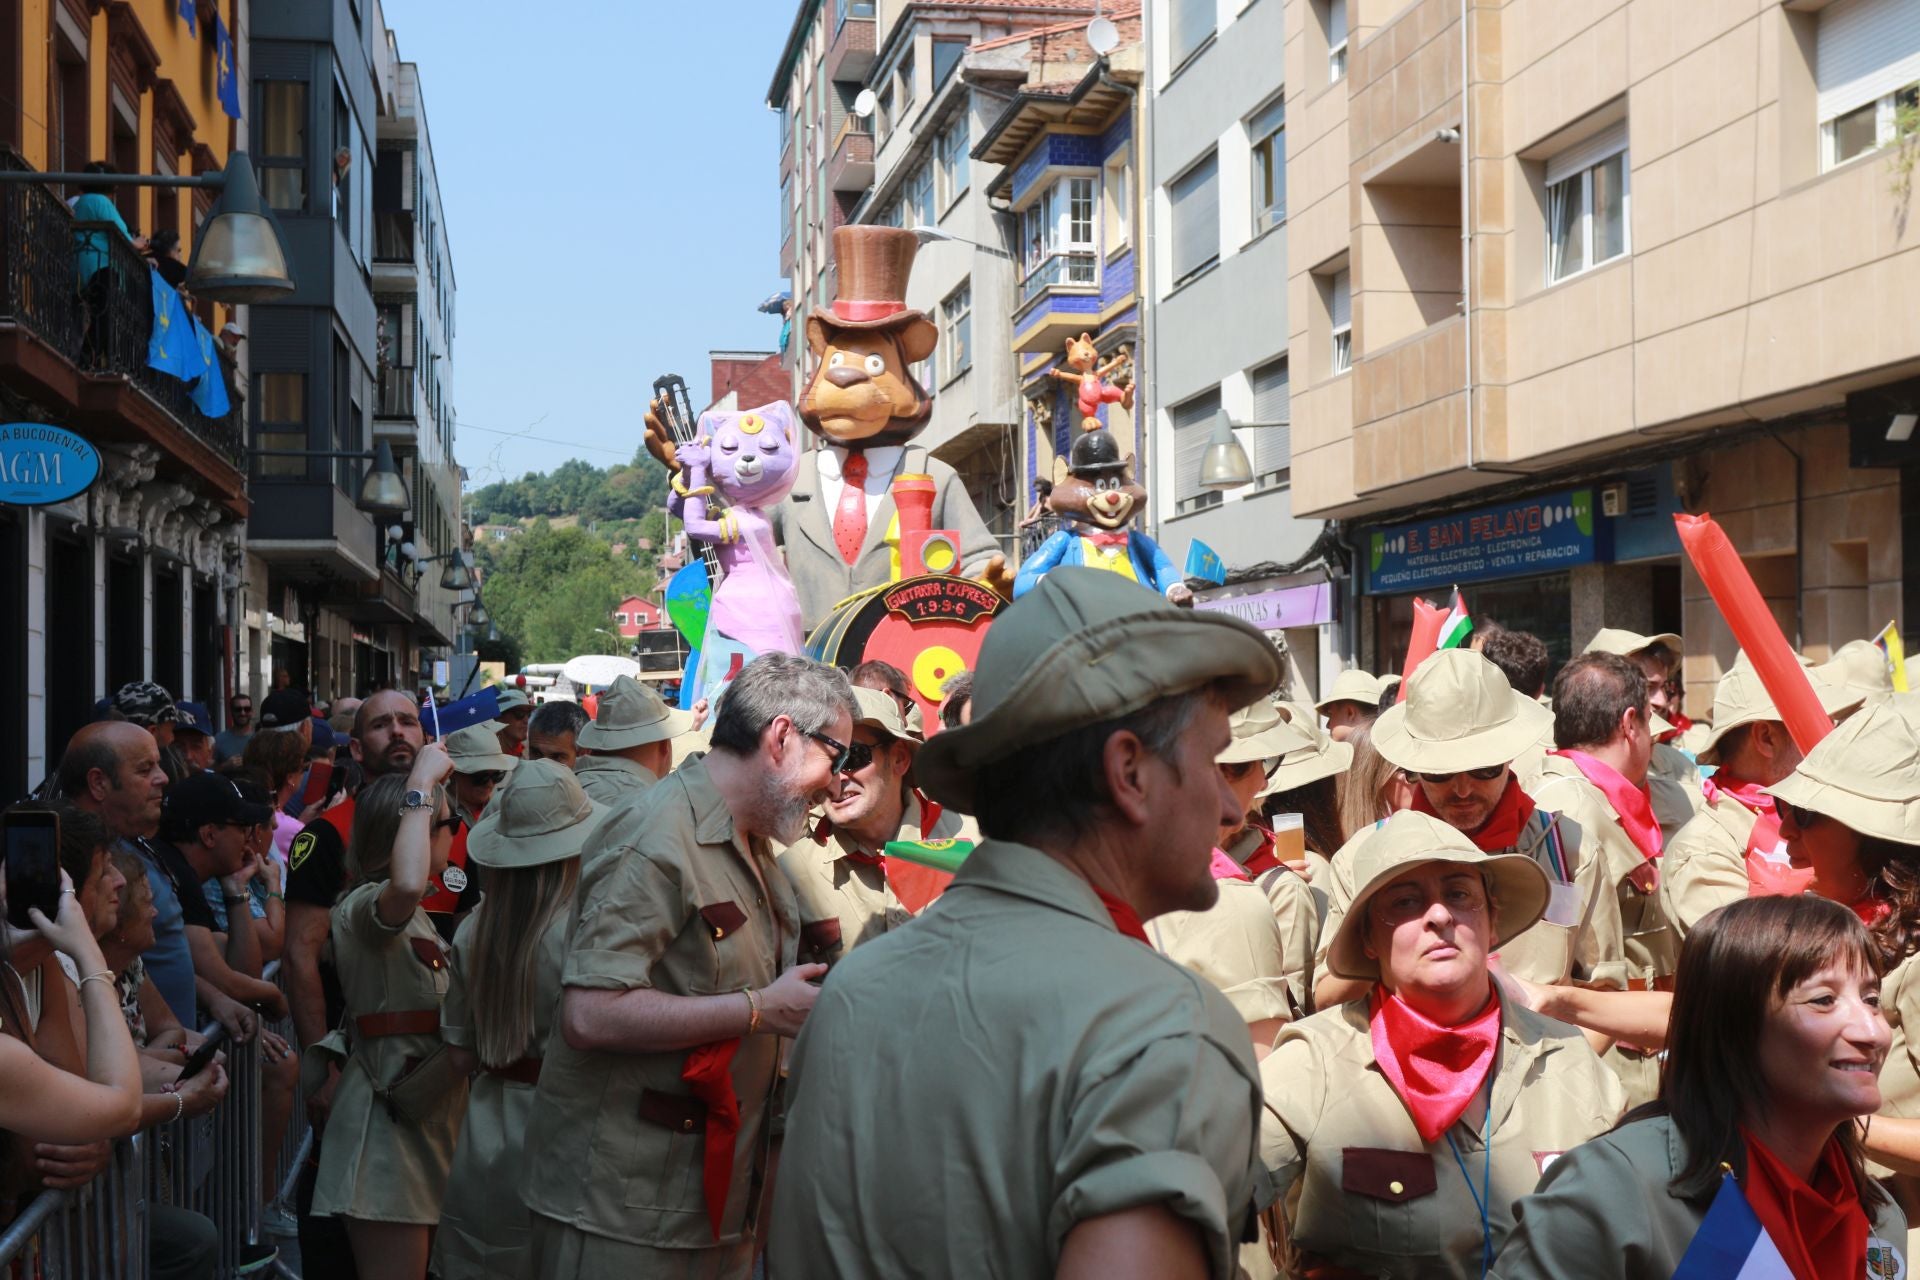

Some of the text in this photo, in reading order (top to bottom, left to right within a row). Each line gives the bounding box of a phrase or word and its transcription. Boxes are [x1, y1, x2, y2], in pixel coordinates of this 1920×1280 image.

[13, 427, 90, 461] BUCODENTAL
[1408, 505, 1542, 554] E. SAN PELAYO
[1407, 552, 1439, 567] MATERIAL
[1412, 559, 1485, 580] ELECTRODOMESTICO
[1490, 554, 1515, 568] VENTA
[1525, 544, 1580, 563] REPARACION
[946, 582, 997, 610] EXPRESS
